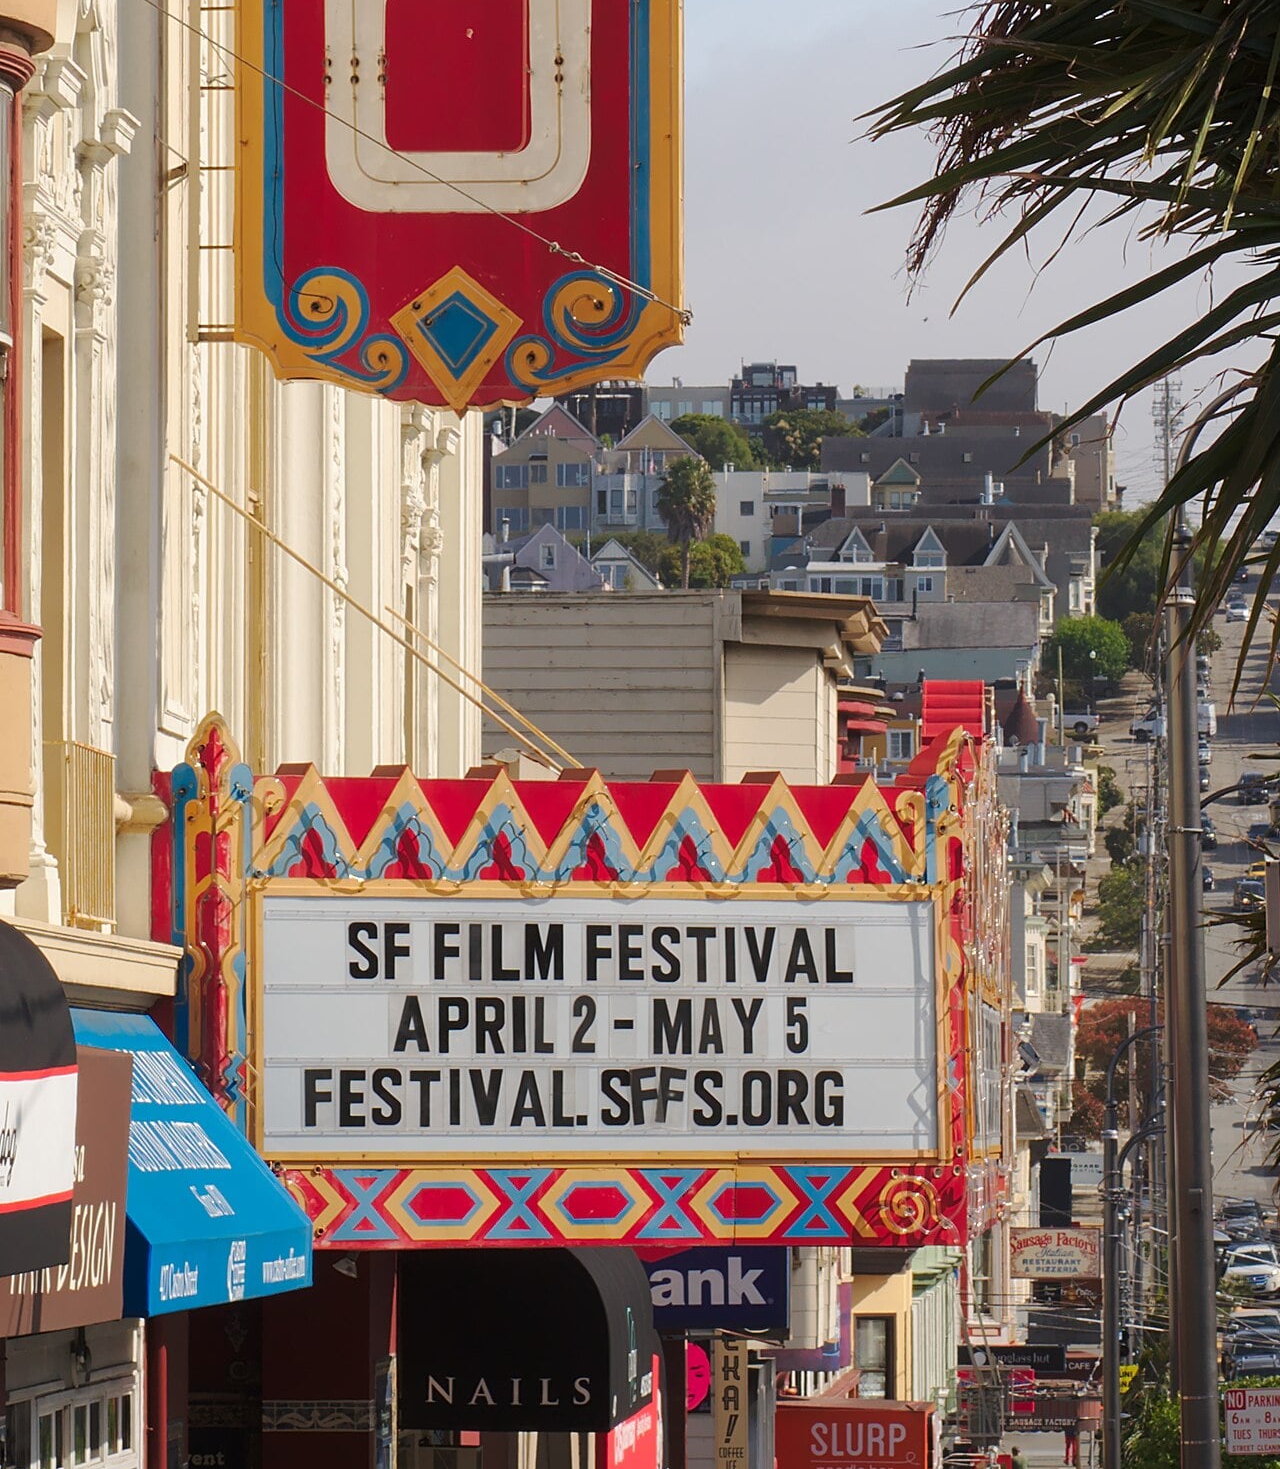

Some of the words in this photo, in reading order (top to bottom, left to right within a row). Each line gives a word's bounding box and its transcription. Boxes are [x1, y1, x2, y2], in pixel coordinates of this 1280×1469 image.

[348, 922, 411, 981] SF
[433, 923, 565, 982] FILM
[586, 924, 854, 984] FESTIVAL
[393, 995, 554, 1054] APRIL
[571, 995, 597, 1054] 2
[652, 997, 765, 1055] MAY
[785, 997, 809, 1054] 5
[1010, 1233, 1053, 1255] Sausage
[1056, 1232, 1097, 1255] Factory
[650, 1257, 770, 1307] ank
[1068, 1362, 1091, 1370] CAFE
[425, 1374, 597, 1406] NAILS
[1227, 1392, 1245, 1408] NO
[810, 1422, 907, 1458] SLURP
[1233, 1430, 1252, 1440] TUES
[719, 1447, 745, 1459] COFFEE
[1232, 1443, 1254, 1452] STREET
